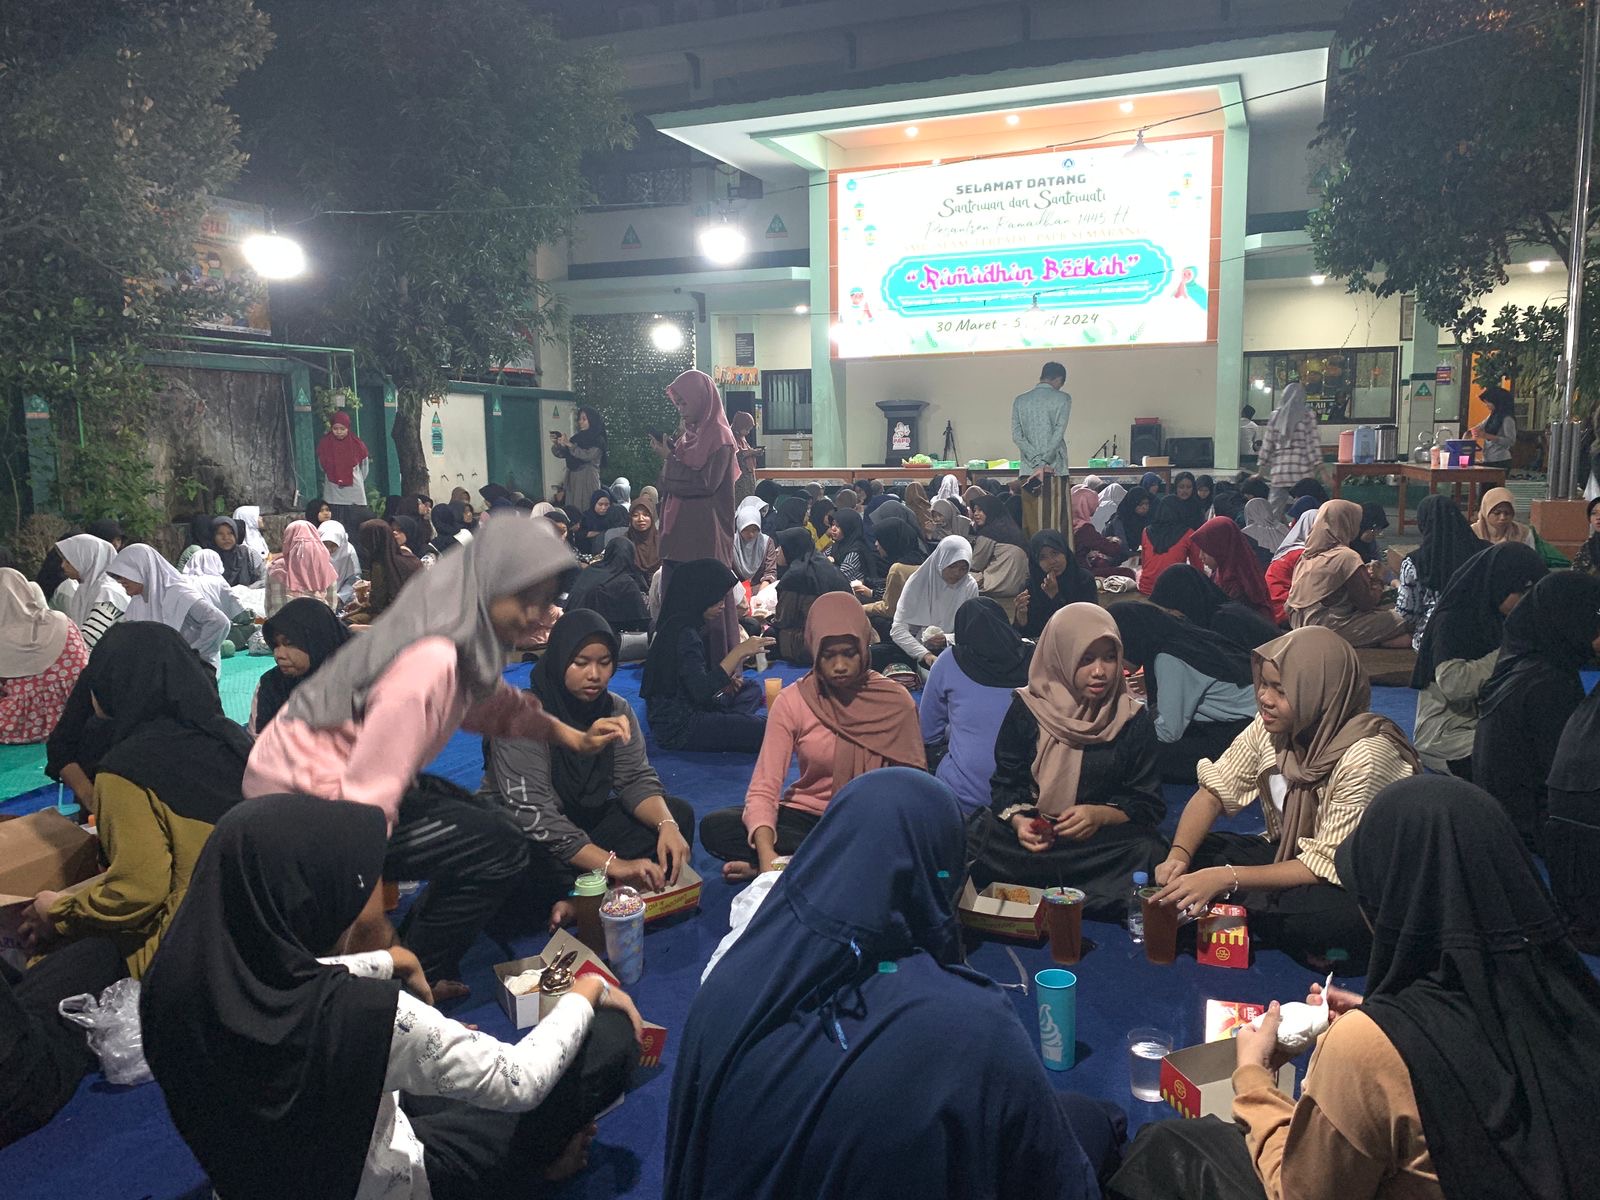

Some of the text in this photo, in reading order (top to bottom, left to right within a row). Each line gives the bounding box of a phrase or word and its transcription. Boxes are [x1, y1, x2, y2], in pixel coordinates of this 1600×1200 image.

[956, 174, 1087, 195] SELAMAT DATANG
[938, 187, 1106, 218] Santriwan dan Santriwati
[936, 321, 952, 333] 30
[955, 318, 997, 332] Maret
[1063, 313, 1099, 326] 2024
